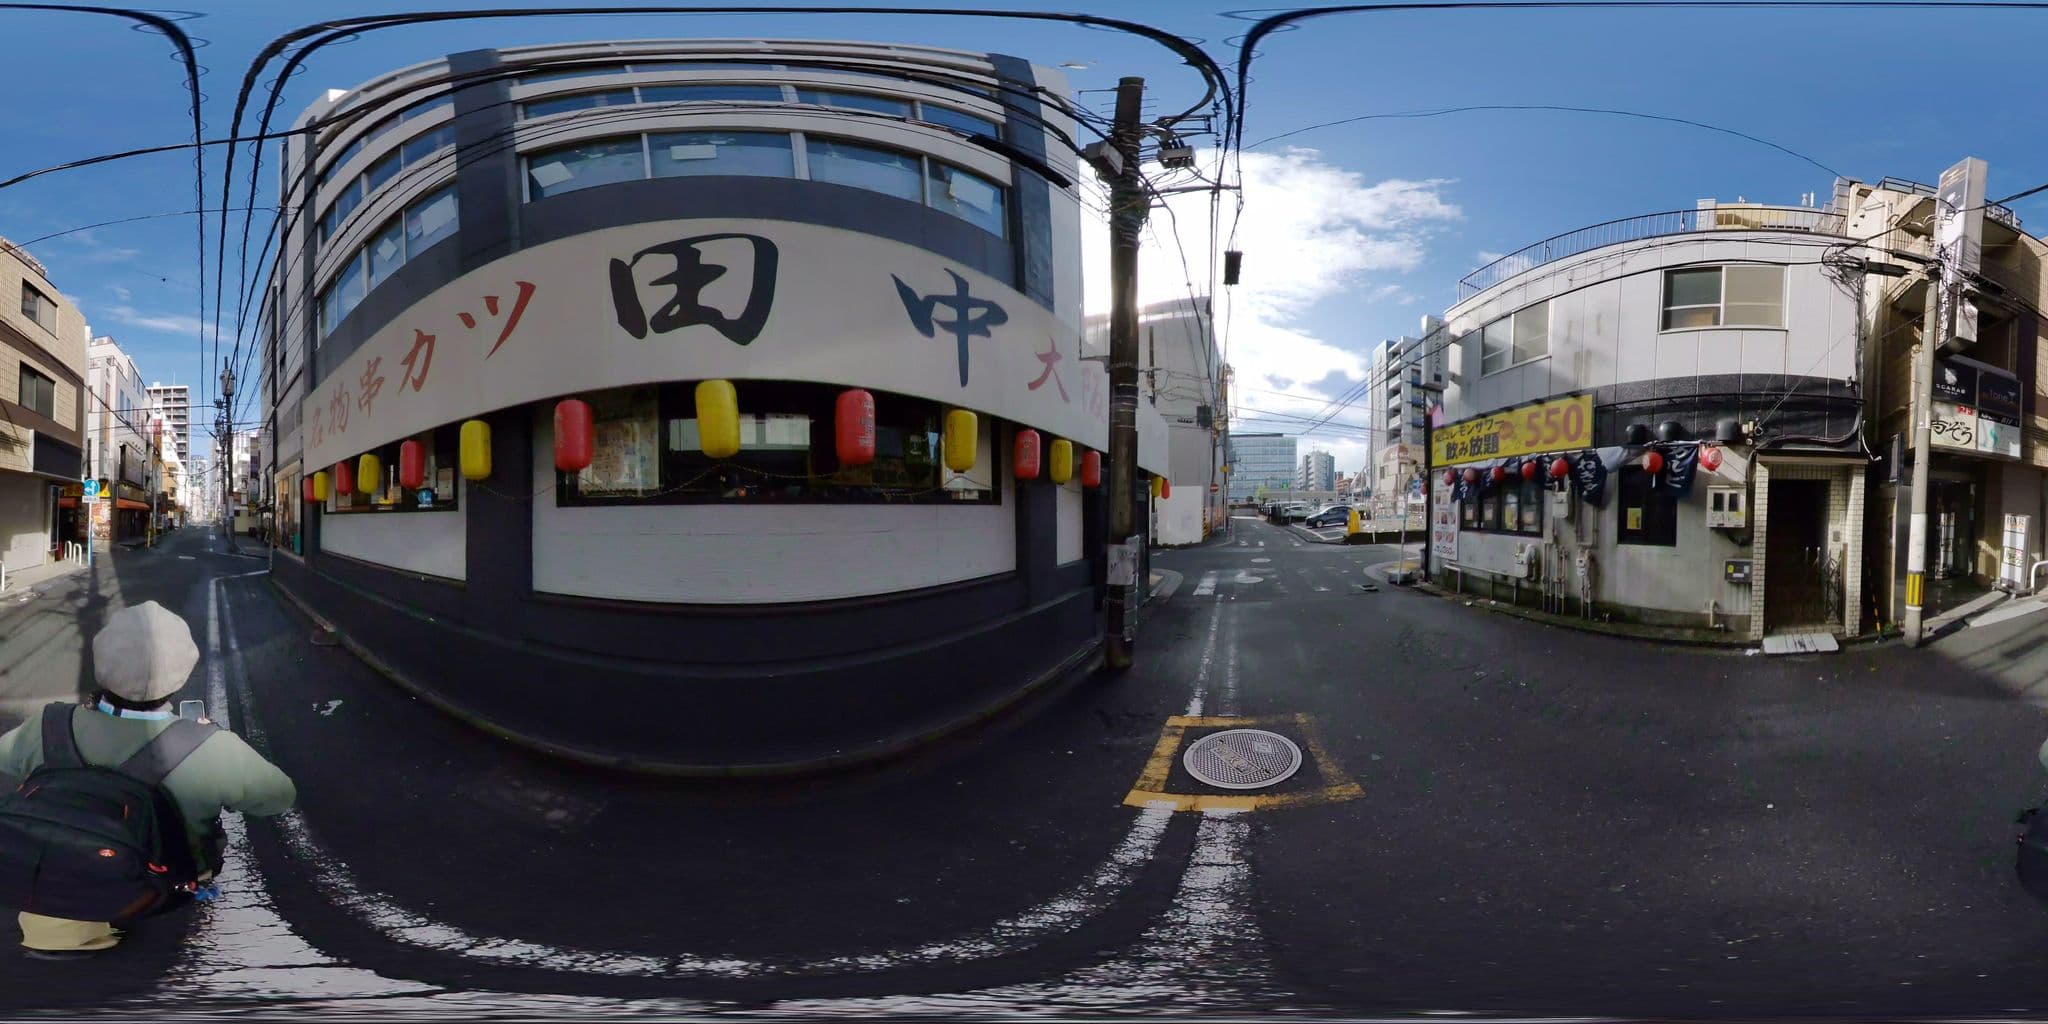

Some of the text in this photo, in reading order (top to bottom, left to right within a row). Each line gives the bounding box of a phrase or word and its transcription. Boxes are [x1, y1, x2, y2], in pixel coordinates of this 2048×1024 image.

[610, 233, 1008, 388] 田中
[1446, 432, 1500, 461] 飲み放題
